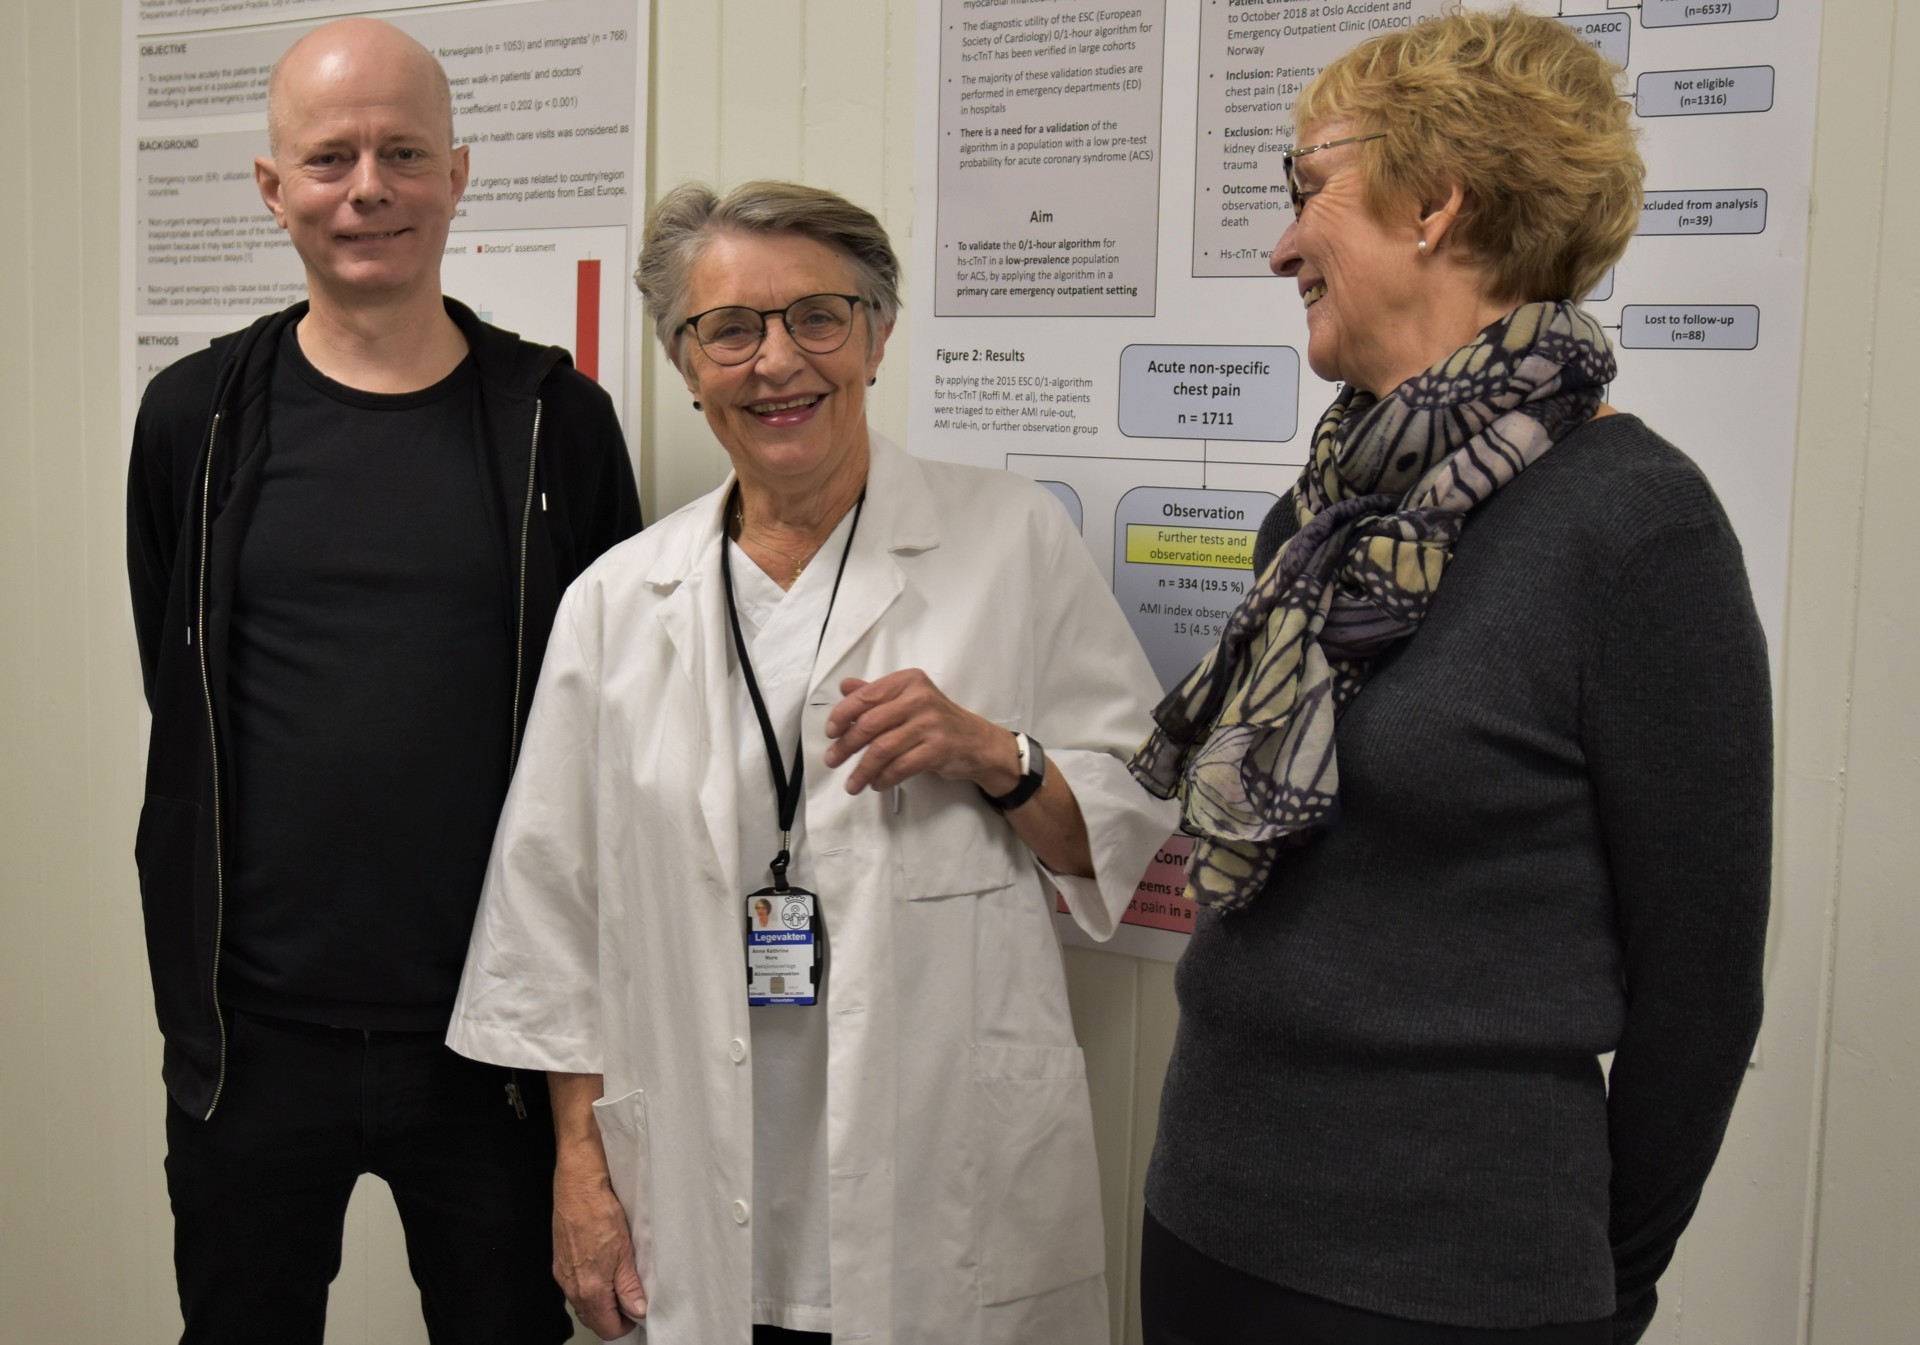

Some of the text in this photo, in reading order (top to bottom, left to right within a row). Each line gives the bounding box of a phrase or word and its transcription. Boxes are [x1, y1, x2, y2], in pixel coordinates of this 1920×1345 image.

[1228, 0, 1412, 23] to October 2018 at Oslo Accident and
[1684, 3, 1732, 18] (n=6537)
[962, 10, 1142, 31] The diagnostic utility of the ESC (European
[962, 22, 1153, 47] Society of Cardiology) 0/1-hour algorithm for
[1585, 22, 1622, 34] OAEOC
[140, 44, 187, 56] OBJECTIVE
[438, 46, 484, 57] Norwegians
[485, 44, 494, 55] (n
[502, 40, 526, 52] 1053)
[526, 39, 542, 50] and
[592, 33, 601, 45] (n
[610, 30, 628, 41] 768)
[961, 41, 1136, 62] hs-cTnT has been verified in large cohorts
[1227, 46, 1264, 56] Norway
[471, 74, 499, 84] walk-in
[534, 68, 550, 80] and
[961, 65, 1144, 85] The majority of these validation studies are
[1226, 67, 1315, 80] Inclusion: Patients
[960, 79, 1142, 101] performed in emergency departments (ED)
[1674, 78, 1735, 91] Not eligible
[510, 99, 533, 111] 0.202
[534, 99, 543, 111] (p
[551, 96, 578, 108] 0.001)
[1680, 94, 1727, 107] (n=1316)
[960, 103, 1006, 115] in hospitals
[461, 124, 630, 145] walk-in health care visits was considered as
[960, 120, 1118, 137] There is a need for a validation of the
[1224, 126, 1273, 137] Exclusion:
[139, 139, 199, 151] BACKGROUND
[1223, 143, 1256, 155] kidney
[471, 177, 480, 187] of
[480, 178, 512, 189] urgency
[513, 177, 530, 185] was
[530, 174, 558, 184] related
[559, 173, 568, 183] to
[496, 192, 523, 202] among
[524, 189, 556, 201] patients
[557, 188, 576, 198] from
[577, 186, 596, 197] East
[1642, 199, 1759, 210] xcluded from analysis
[1029, 210, 1054, 223] Aim
[1678, 215, 1713, 227] (n=39)
[514, 244, 556, 253] assessment
[958, 238, 1116, 251] To validate the 0/1-hour algorithm for
[956, 285, 1138, 297] primary care emergency outpatient setting
[1645, 314, 1735, 326] Lost to follow-up
[138, 336, 179, 346] METHODS
[1671, 330, 1706, 342] (n=88)
[936, 349, 1025, 364] Figure 2: Results
[1147, 361, 1270, 376] Acute non-specific
[1173, 382, 1241, 399] chest pain
[1178, 414, 1186, 424] n
[1202, 412, 1234, 425] 1711
[1162, 504, 1245, 520] Observation
[1158, 531, 1247, 547] Further tests and
[1158, 579, 1166, 587] n
[1178, 578, 1198, 589] 334
[1201, 579, 1228, 592] (19.5
[1230, 581, 1244, 595] %)
[1139, 603, 1193, 616] AMI index
[1140, 902, 1192, 919] pain in a
[754, 933, 806, 944] Legevakten
